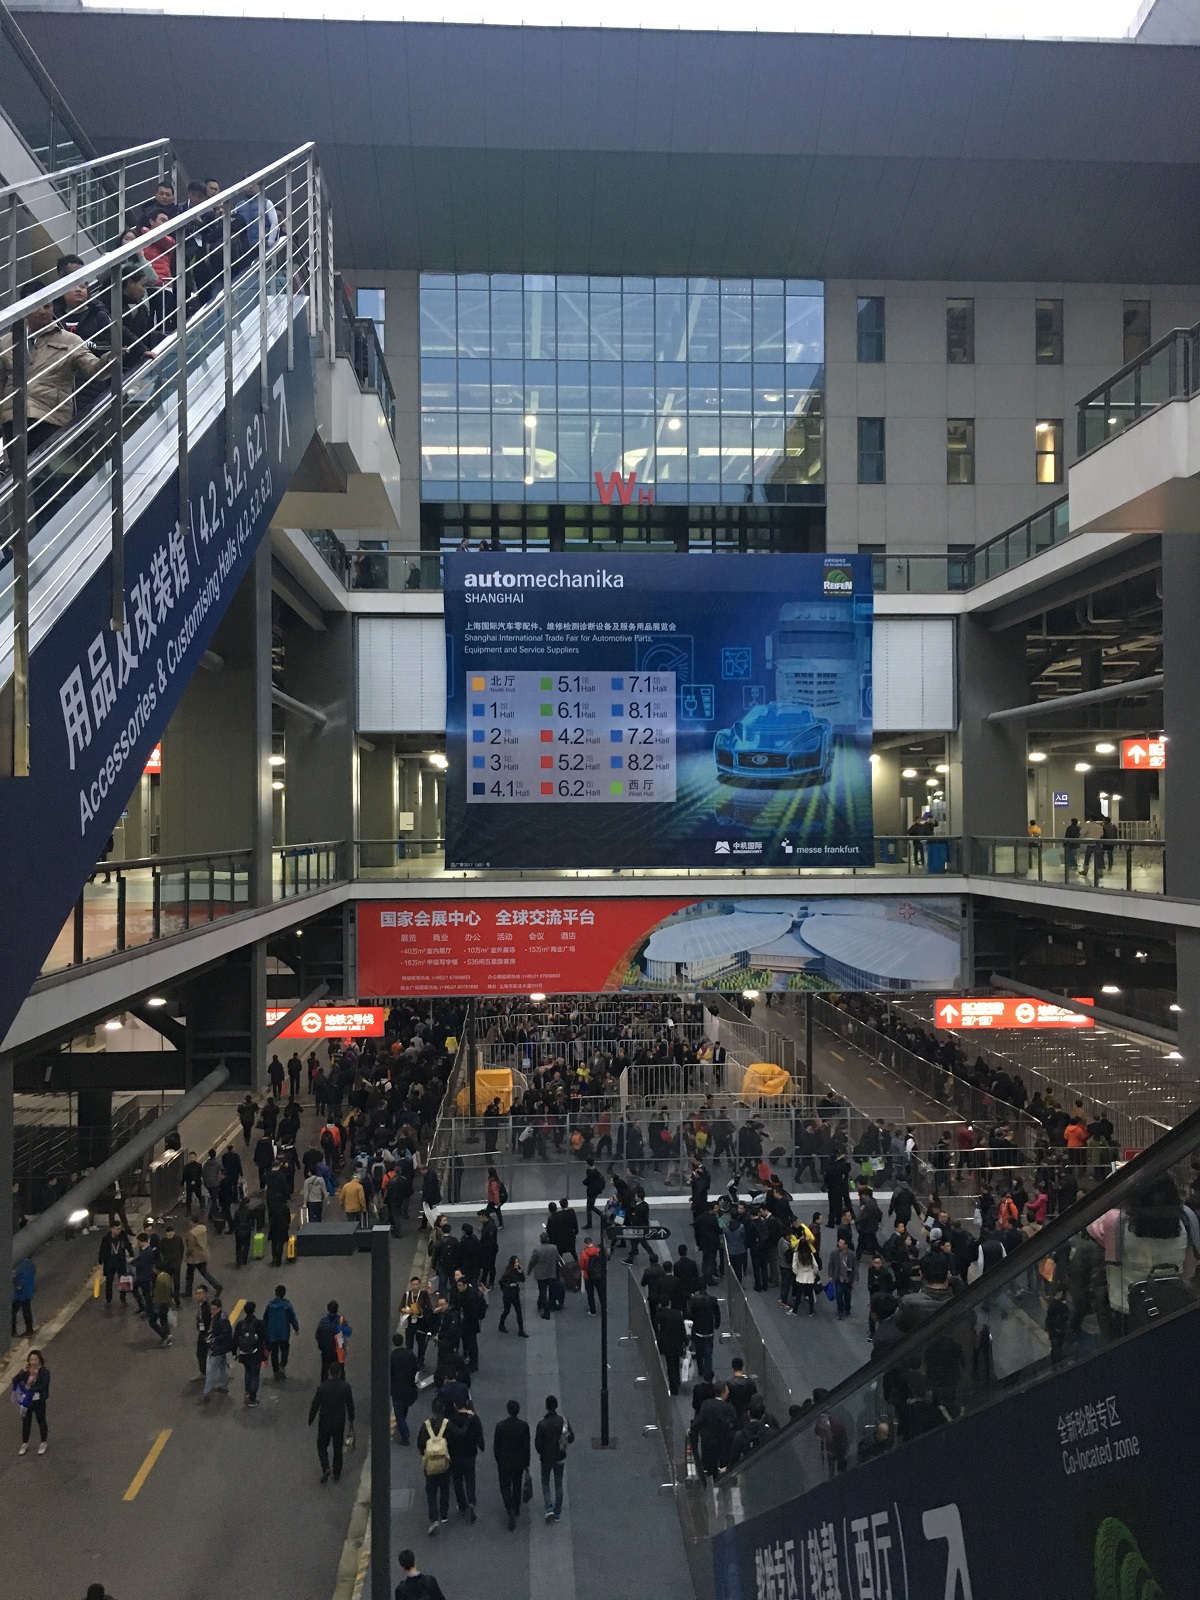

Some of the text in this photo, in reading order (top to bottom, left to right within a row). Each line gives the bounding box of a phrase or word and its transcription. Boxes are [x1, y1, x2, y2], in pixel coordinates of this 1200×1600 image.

[464, 569, 624, 588] automechanika
[464, 593, 524, 603] SHANGHAI
[464, 634, 653, 643] Shanghai International Trade Fair for Automotive Parts,
[464, 646, 580, 655] Equipment and Service Suppliers
[80, 683, 157, 837] Accessories
[156, 658, 168, 694] &
[166, 577, 221, 677] Customising
[218, 537, 237, 584] Halls
[490, 675, 515, 687] 北厅
[558, 676, 580, 693] 5.1
[628, 676, 651, 693] 7.1
[652, 685, 668, 693] Hall
[490, 702, 497, 718] 1
[558, 702, 580, 719] 6.1
[628, 702, 651, 719] 8.1
[490, 728, 502, 744] 2
[558, 728, 584, 745] 4.2
[585, 737, 600, 745] Hall
[628, 728, 654, 745] 7.2
[490, 754, 502, 771] 3
[504, 763, 519, 771] Hall
[558, 754, 584, 771] 5.2
[585, 763, 600, 771] Hall
[628, 754, 654, 771] 8.2
[655, 763, 670, 771] Hall
[490, 780, 514, 797] 4.1
[515, 789, 531, 797] Hall
[558, 780, 584, 797] 6.2
[629, 780, 653, 790] 西厅
[796, 845, 859, 854] messe frankfurt
[380, 909, 595, 928] 国家会展中心 全球交流平台
[401, 932, 576, 942] 展览 商业 办公 活动 会议 酒店
[1057, 1395, 1121, 1445] 全新轮胎专区
[1062, 1435, 1140, 1475] Co-located zone
